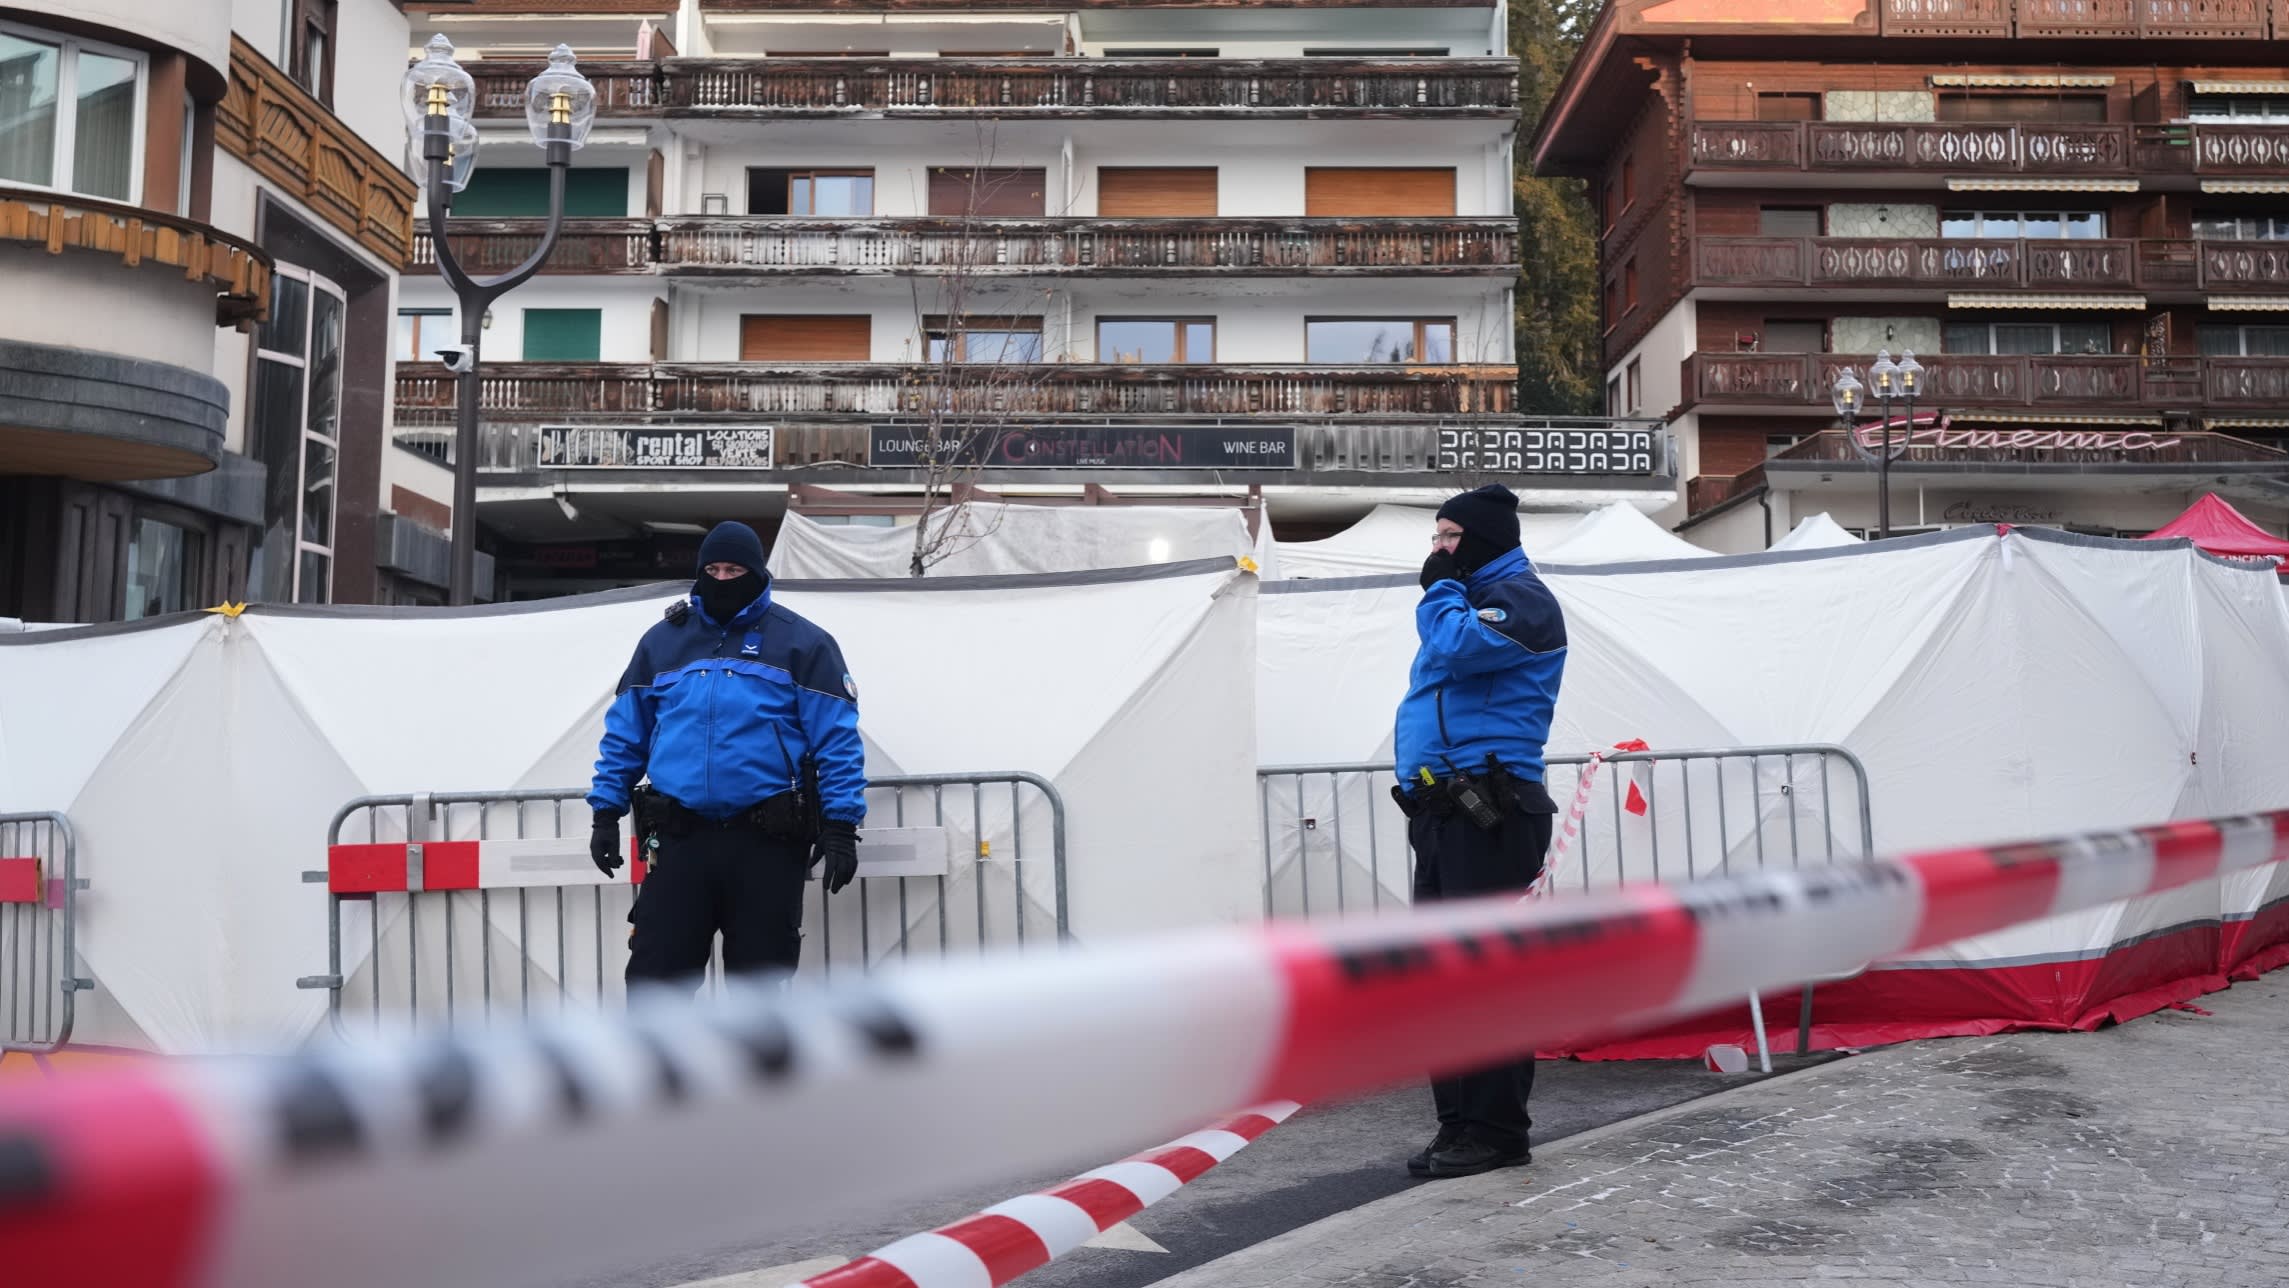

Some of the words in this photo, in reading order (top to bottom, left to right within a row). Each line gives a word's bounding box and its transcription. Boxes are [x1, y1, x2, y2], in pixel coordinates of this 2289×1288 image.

[706, 430, 769, 441] LOCATIONS
[1854, 412, 2180, 448] Cinema
[637, 432, 703, 456] rental
[935, 440, 961, 453] BAR
[1223, 441, 1257, 454] WINE
[1259, 441, 1286, 454] BAR
[720, 448, 759, 458] VENTE
[637, 456, 672, 465] SPORT
[675, 456, 704, 465] SHOP
